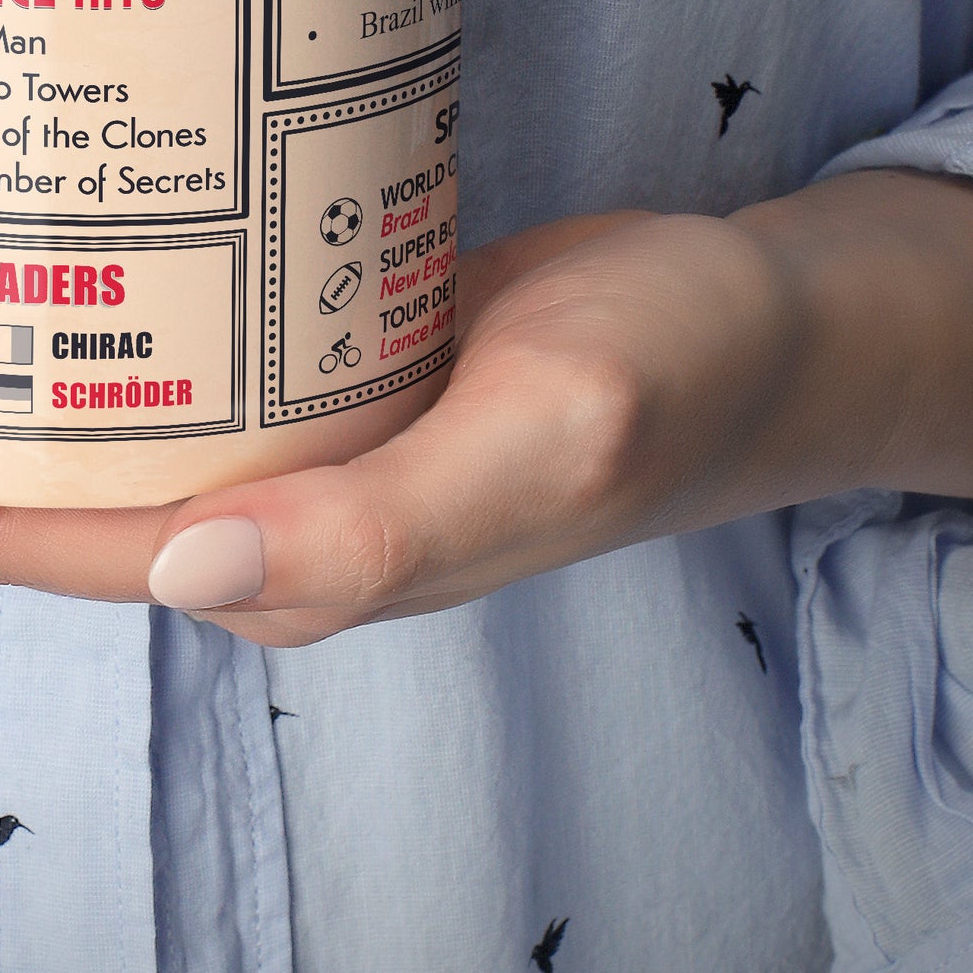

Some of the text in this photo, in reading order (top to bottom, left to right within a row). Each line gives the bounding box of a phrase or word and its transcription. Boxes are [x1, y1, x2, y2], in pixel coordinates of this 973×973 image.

[22, 73, 129, 104] Towers
[2, 116, 30, 155] of
[44, 117, 90, 148] the
[101, 118, 207, 149] Clones
[78, 165, 106, 203] of
[118, 165, 226, 196] Secrets
[380, 152, 458, 209] WORLD C
[380, 195, 430, 238] Brazil
[380, 229, 435, 273] SUPER
[379, 268, 420, 300] New
[379, 290, 429, 333] TOUR
[431, 279, 451, 309] DE
[52, 331, 153, 360] CHIRAC
[379, 323, 429, 360] Lance
[52, 375, 193, 409] SCHRÖDER
